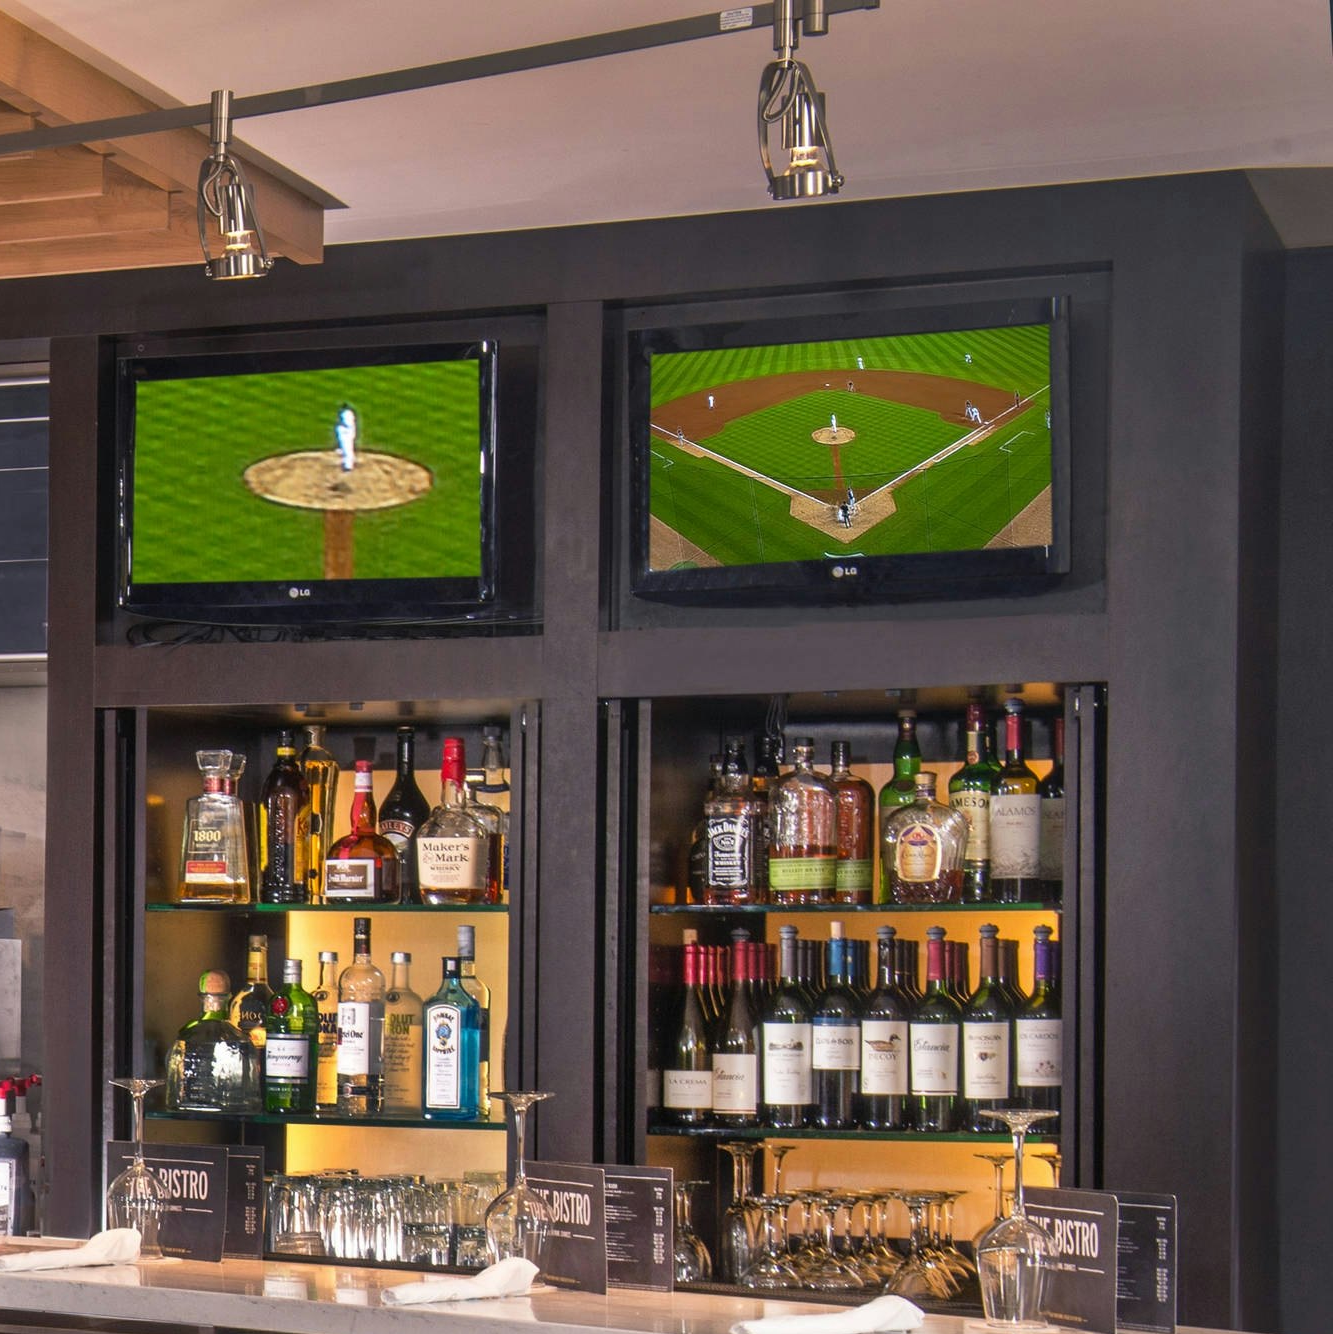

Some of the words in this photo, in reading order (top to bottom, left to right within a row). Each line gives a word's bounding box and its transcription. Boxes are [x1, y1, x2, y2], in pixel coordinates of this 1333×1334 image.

[844, 567, 858, 575] LG
[299, 588, 311, 597] LG
[995, 806, 1036, 817] ALAMOS
[194, 829, 221, 842] 1800
[421, 842, 470, 853] Maker's
[434, 853, 469, 863] Mark
[913, 1038, 950, 1052] Estancia
[868, 1052, 897, 1061] DECOY
[552, 1191, 591, 1226] BISTRO
[1054, 1218, 1099, 1259] BISTRO
